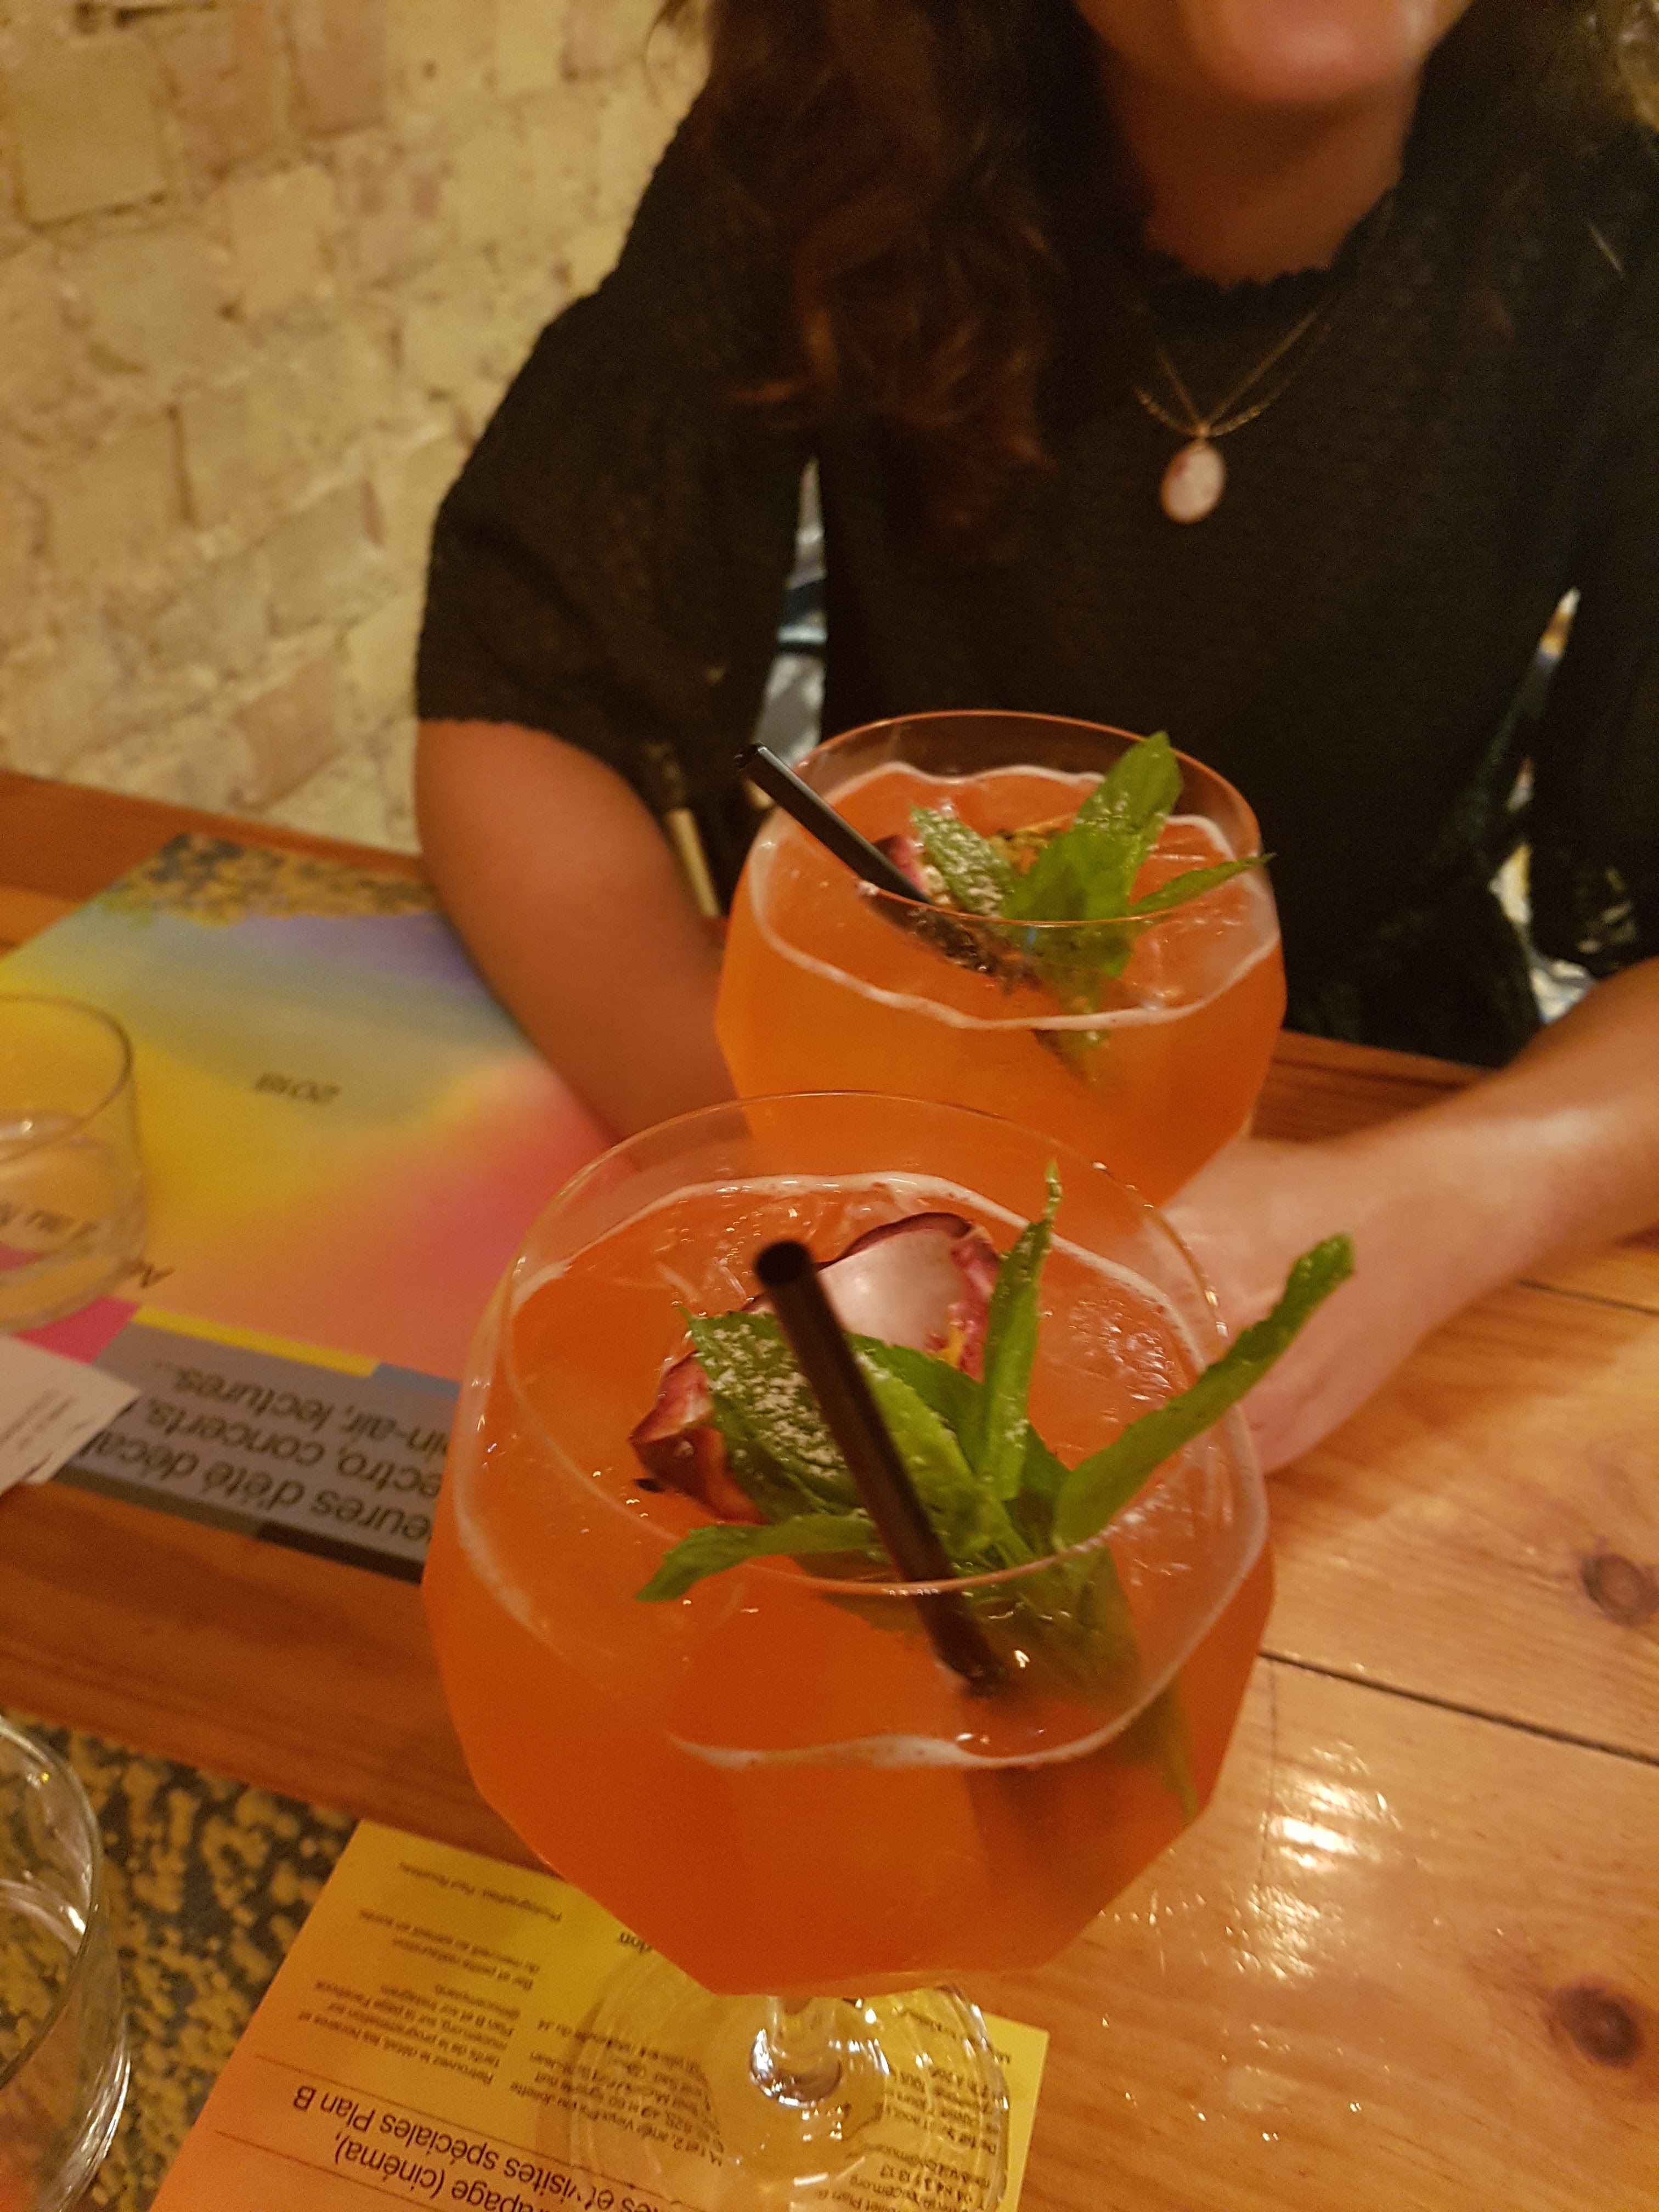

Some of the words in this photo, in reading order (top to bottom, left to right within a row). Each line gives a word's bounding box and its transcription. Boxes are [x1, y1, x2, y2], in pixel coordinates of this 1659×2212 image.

[312, 1486, 433, 1547] eures
[292, 2083, 316, 2111] B
[317, 2091, 376, 2132] Plan
[328, 2132, 447, 2199] (cinéma),
[376, 2107, 500, 2177] spéciales
